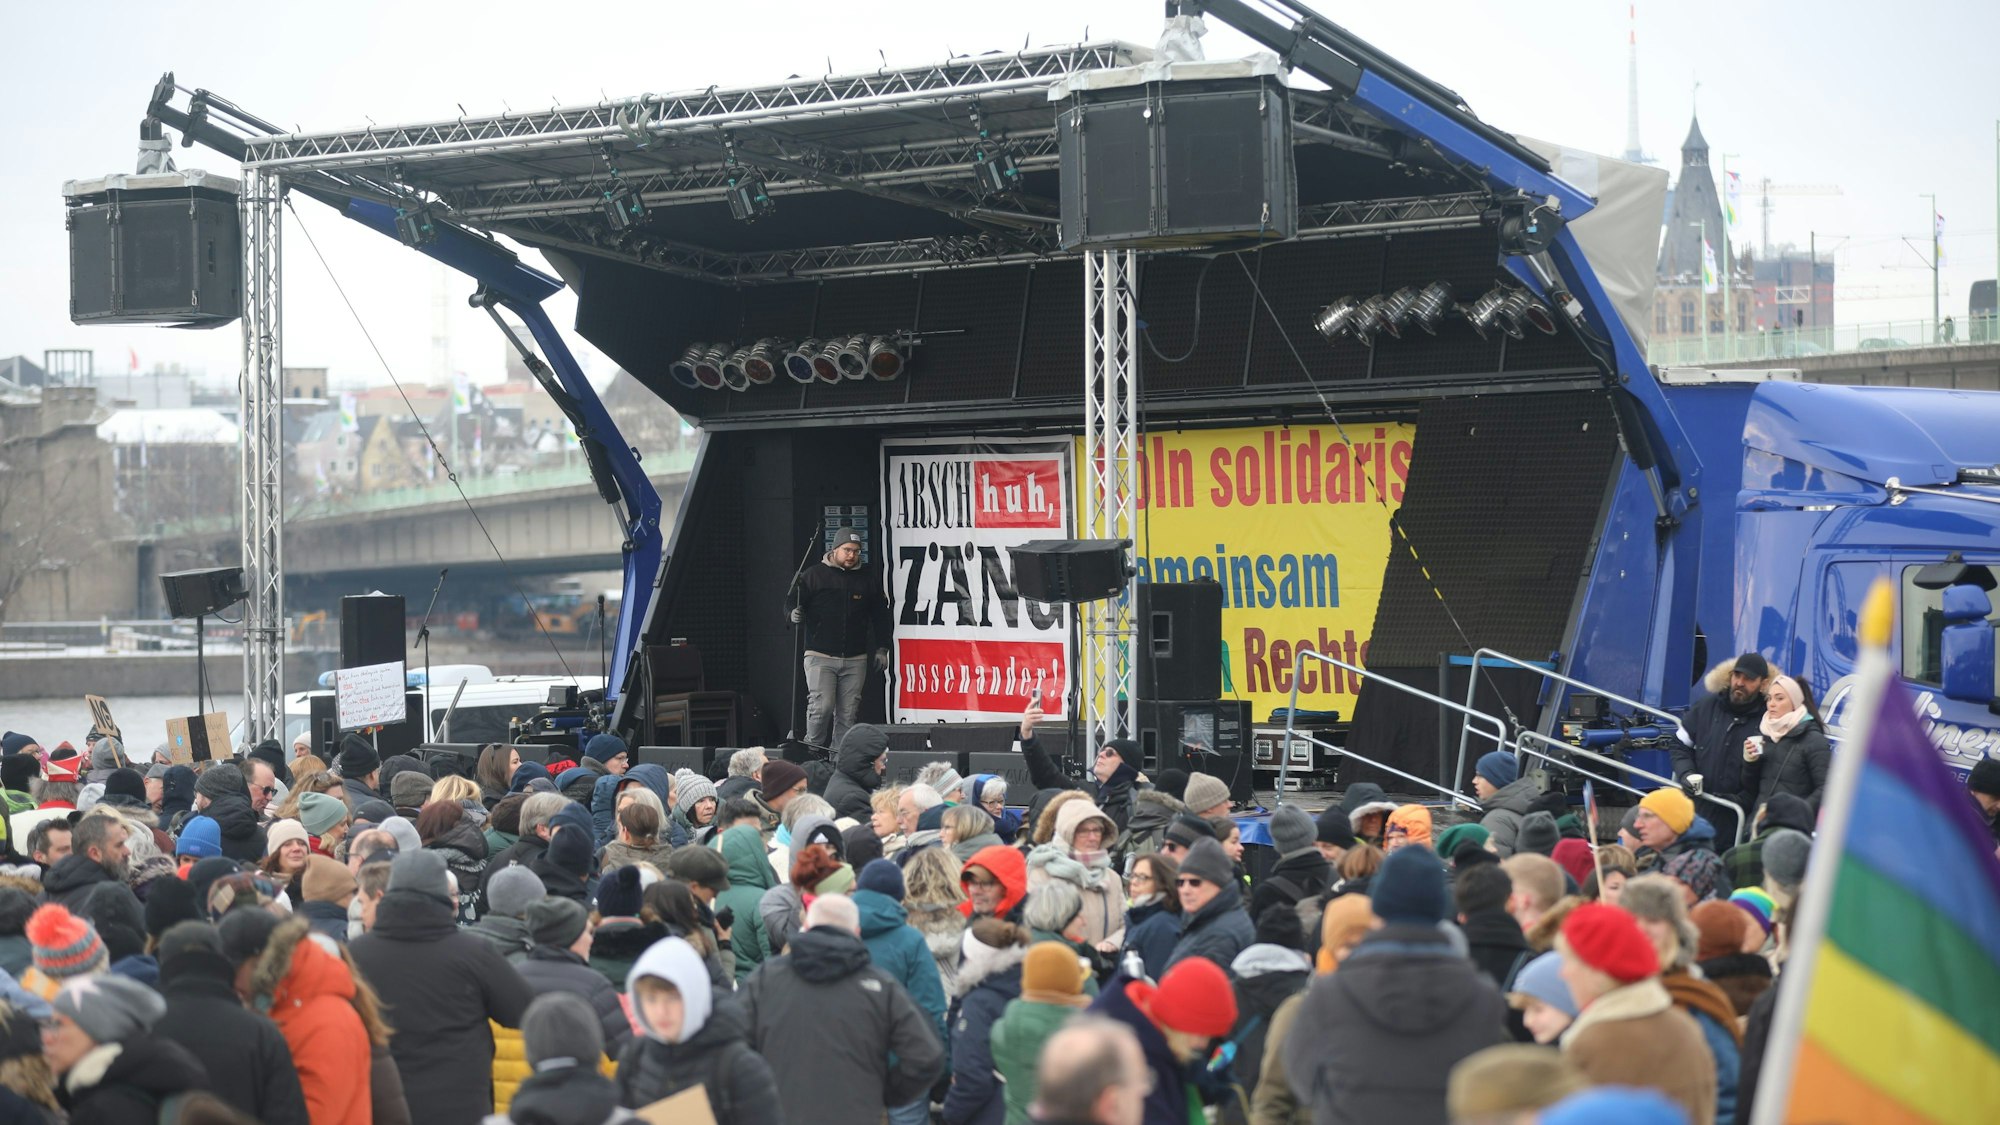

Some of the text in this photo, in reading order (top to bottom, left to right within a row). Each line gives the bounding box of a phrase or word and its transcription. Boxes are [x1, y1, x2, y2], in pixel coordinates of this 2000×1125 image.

[897, 461, 1054, 529] ARSCH huh,
[1210, 428, 1412, 507] solidaris
[905, 656, 1059, 698] ussenander!
